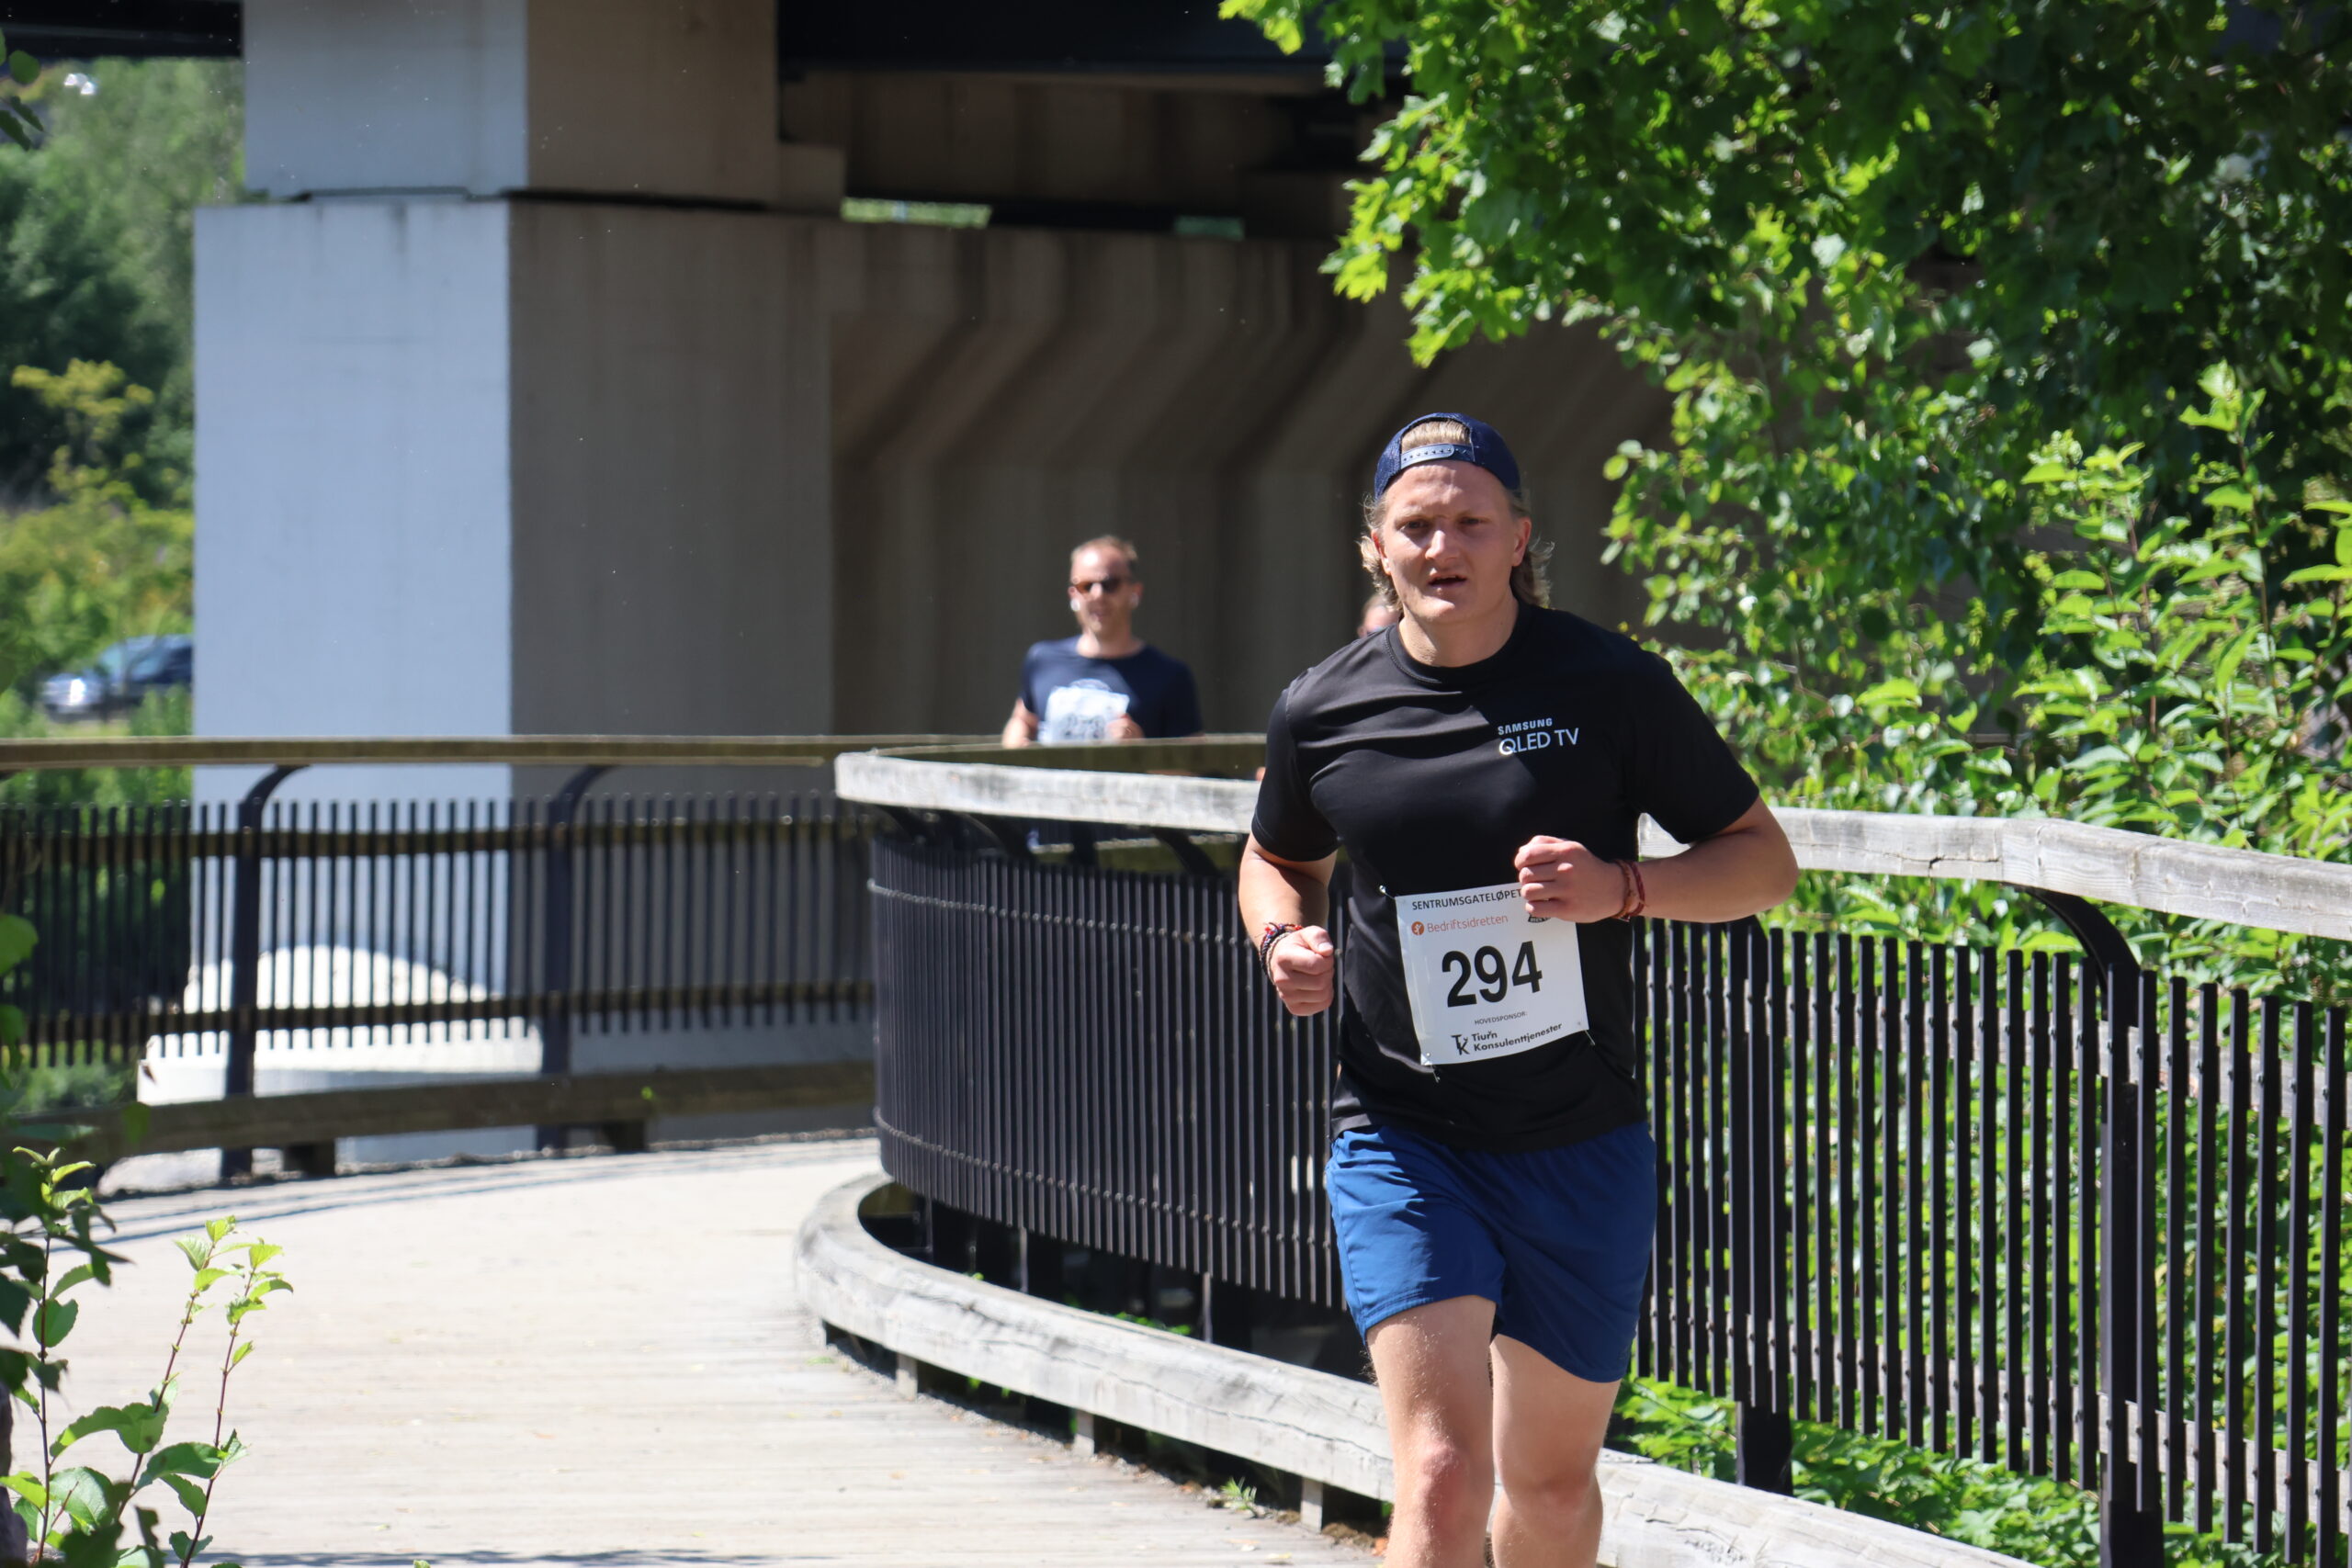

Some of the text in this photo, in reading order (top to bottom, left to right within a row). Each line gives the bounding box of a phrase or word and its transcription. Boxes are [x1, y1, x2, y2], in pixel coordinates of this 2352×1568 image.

[1498, 717, 1553, 735] SAMSUNG
[1498, 728, 1579, 755] QLED TV
[1411, 888, 1521, 910] SENTRUMSGATELØPET
[1427, 915, 1509, 933] Bedriftsidretten
[1442, 941, 1543, 1008] 294
[1474, 1023, 1563, 1052] Konsulenttjenester
